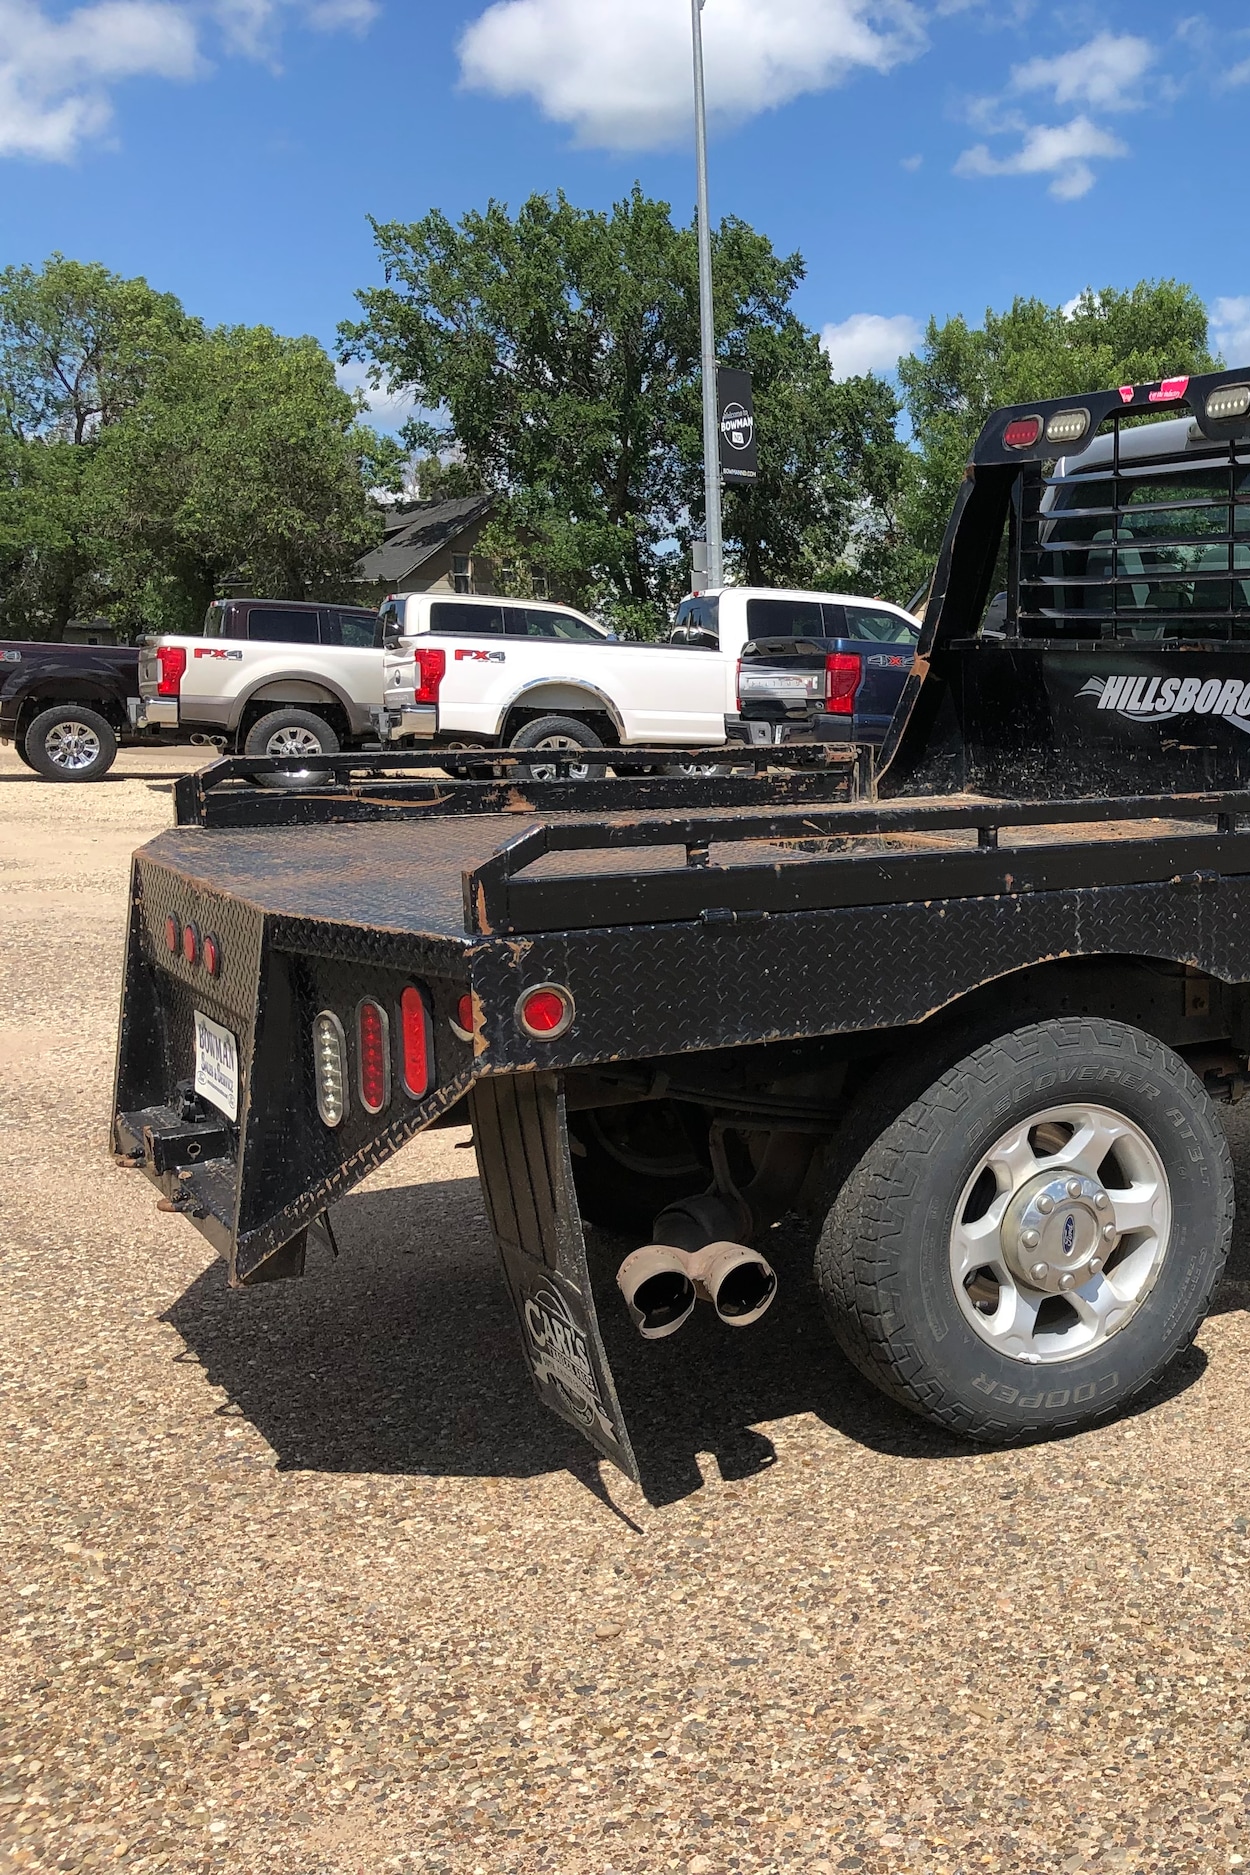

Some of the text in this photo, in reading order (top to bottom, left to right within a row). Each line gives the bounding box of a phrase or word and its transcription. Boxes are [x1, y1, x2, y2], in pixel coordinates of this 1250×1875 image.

[721, 416, 753, 432] BOWMAN
[194, 648, 243, 659] FX4
[454, 649, 506, 661] FX4
[198, 1023, 235, 1072] BOWMAN
[965, 1065, 1161, 1147] DISCOVERER
[1165, 1107, 1207, 1163] AT3
[524, 1298, 590, 1375] CARL'S
[971, 1371, 1119, 1409] COOPER
